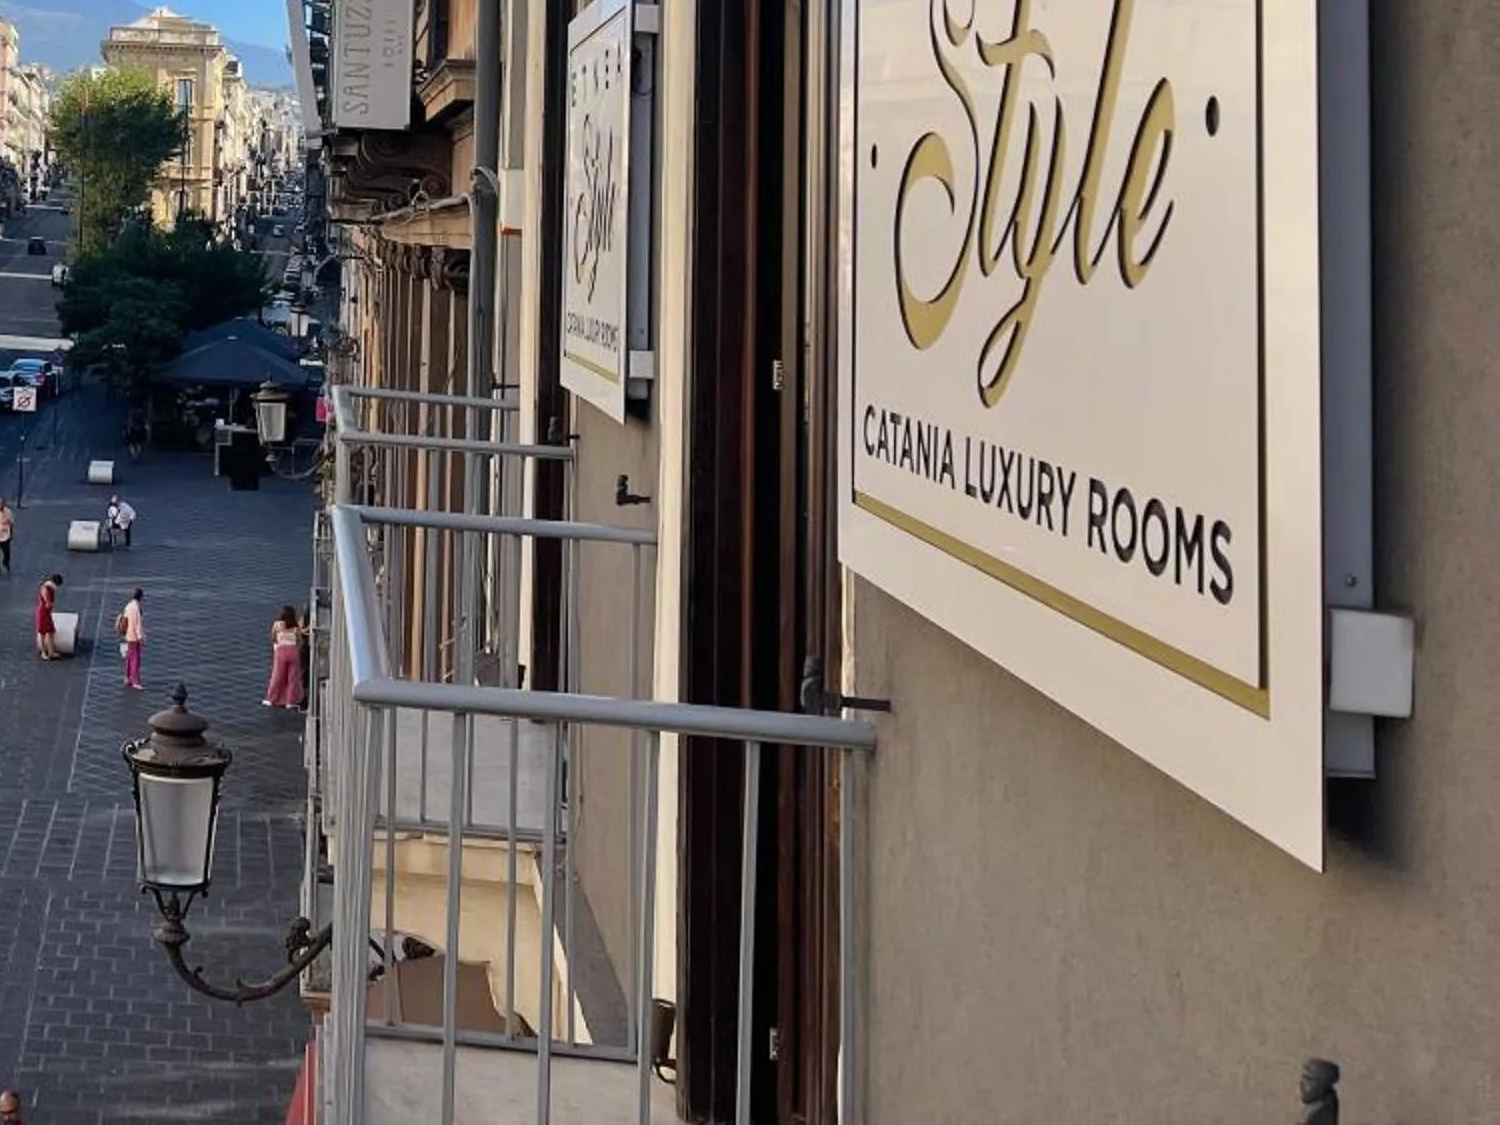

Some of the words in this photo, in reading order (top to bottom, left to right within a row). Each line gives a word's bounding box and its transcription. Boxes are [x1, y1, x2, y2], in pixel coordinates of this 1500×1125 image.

[863, 404, 955, 485] CATANIA
[964, 435, 1076, 538] LUXURY
[1088, 479, 1234, 606] ROOMS
